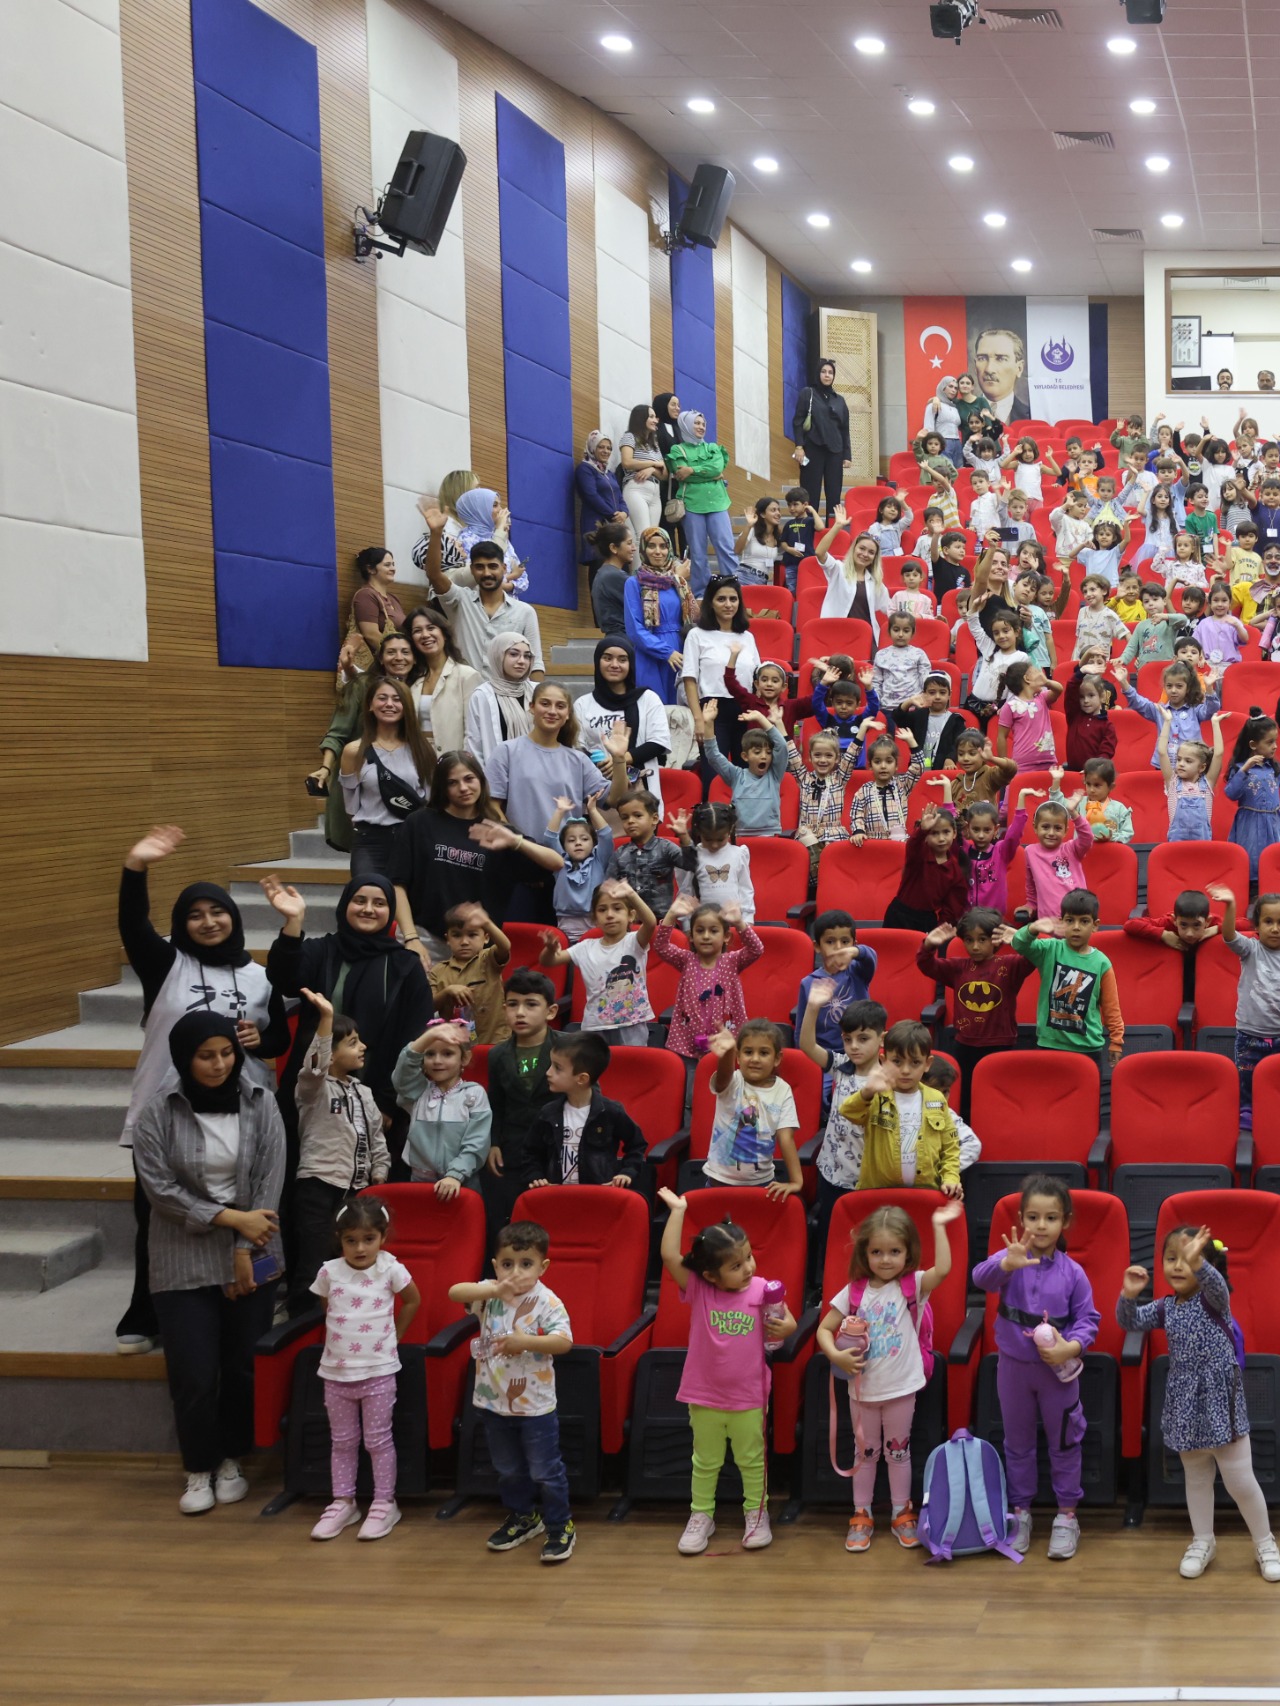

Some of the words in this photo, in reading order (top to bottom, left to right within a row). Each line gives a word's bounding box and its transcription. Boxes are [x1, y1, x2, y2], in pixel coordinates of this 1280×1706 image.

[1059, 383, 1084, 391] BELEDİYESİ
[396, 796, 413, 807] NIKE
[434, 843, 486, 868] TOKYO
[710, 1310, 754, 1331] Dream
[719, 1319, 741, 1336] Big
